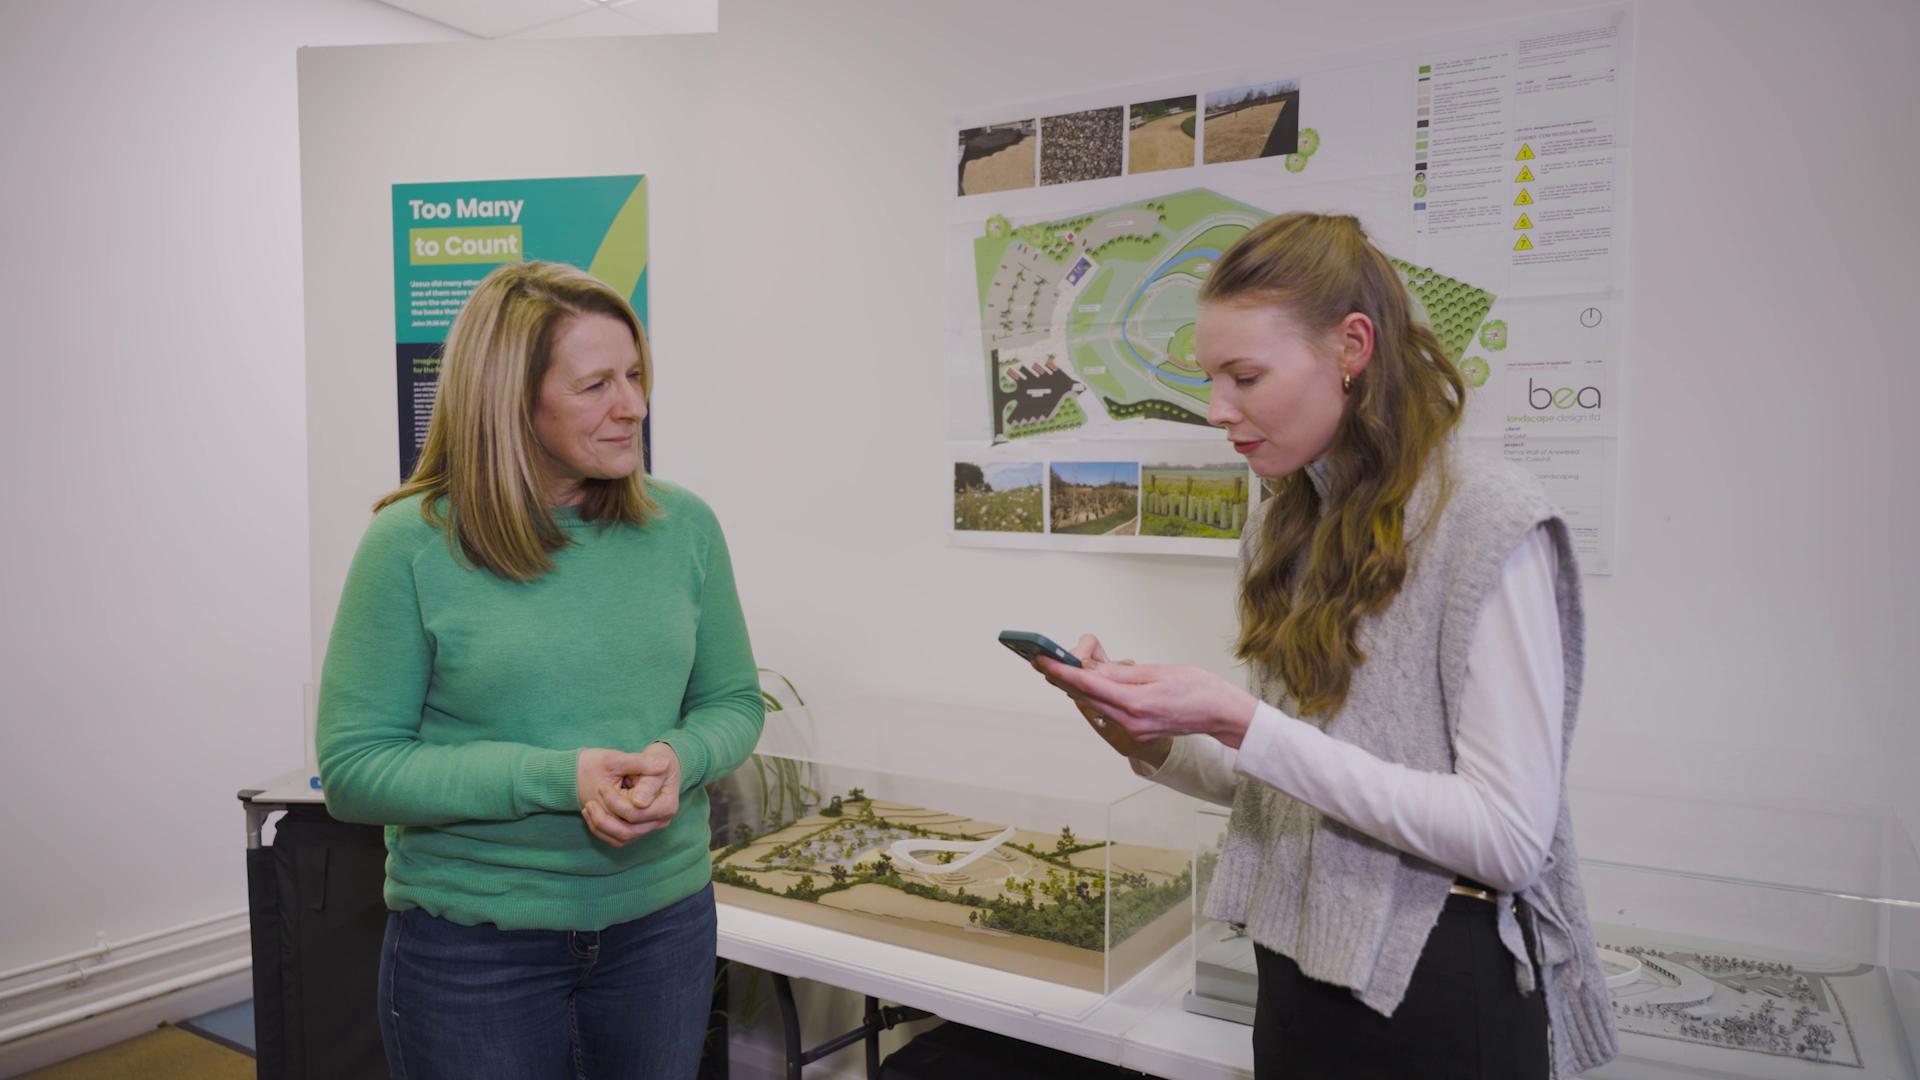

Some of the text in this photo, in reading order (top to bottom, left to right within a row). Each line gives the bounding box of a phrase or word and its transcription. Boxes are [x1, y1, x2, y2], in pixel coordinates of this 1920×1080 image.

[408, 197, 524, 223] Too Many
[415, 234, 518, 256] to Count
[1528, 376, 1602, 410] bea
[1505, 414, 1554, 424] landscape
[1556, 414, 1587, 424] design
